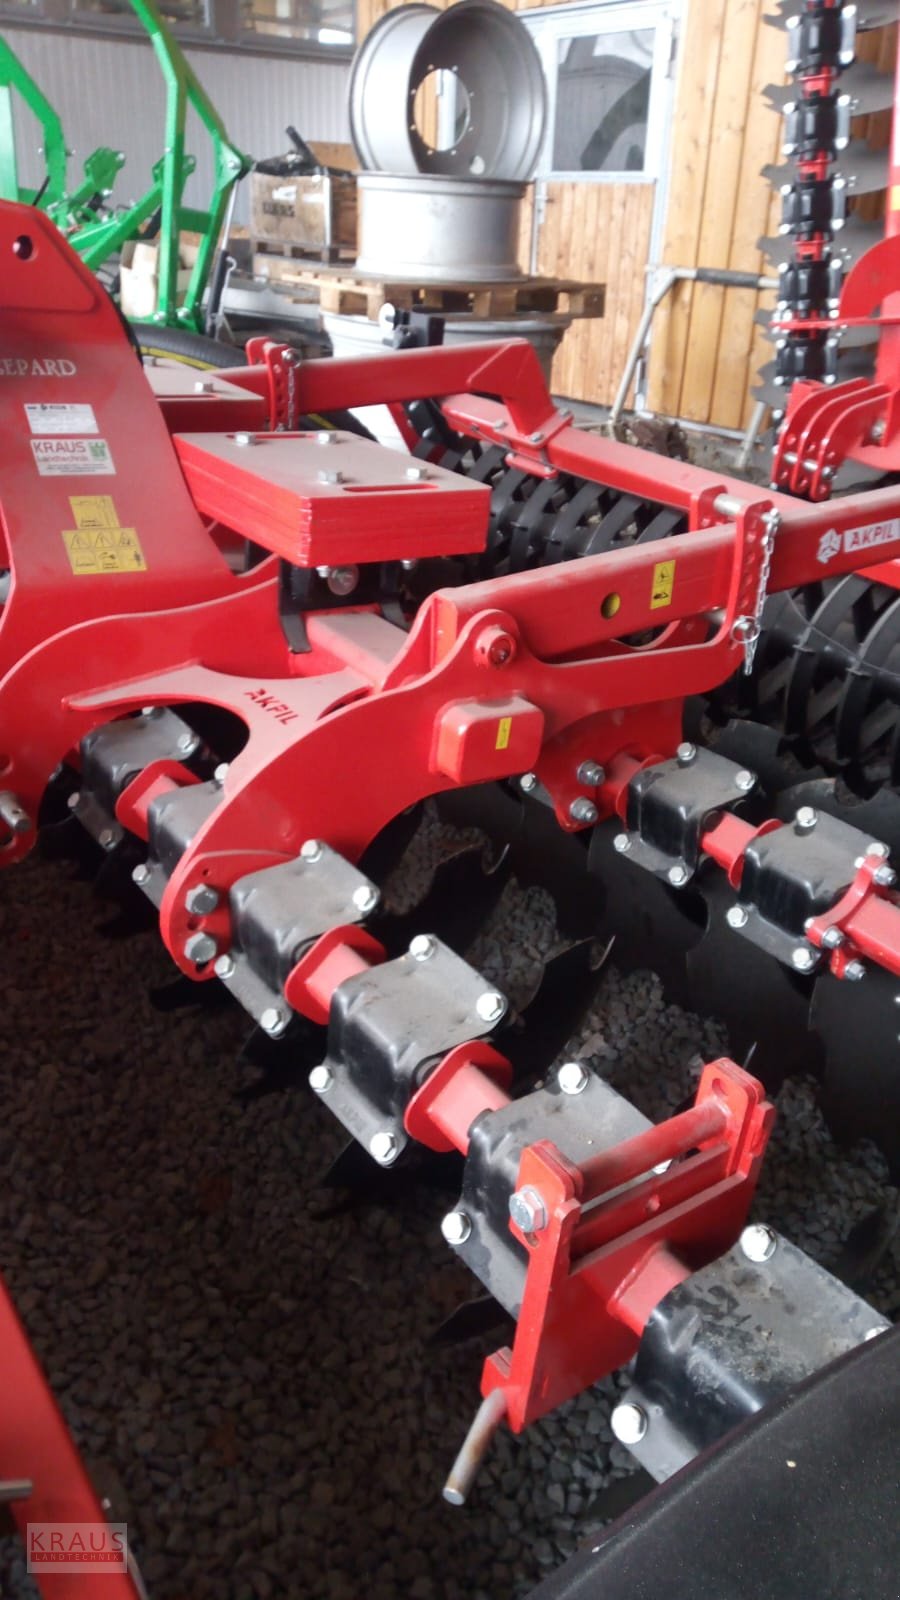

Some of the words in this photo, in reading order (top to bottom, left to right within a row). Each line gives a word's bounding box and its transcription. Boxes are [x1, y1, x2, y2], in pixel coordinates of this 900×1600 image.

[33, 441, 86, 453] KRAUS
[850, 523, 893, 548] AKPIL
[243, 688, 299, 725] AKPIL
